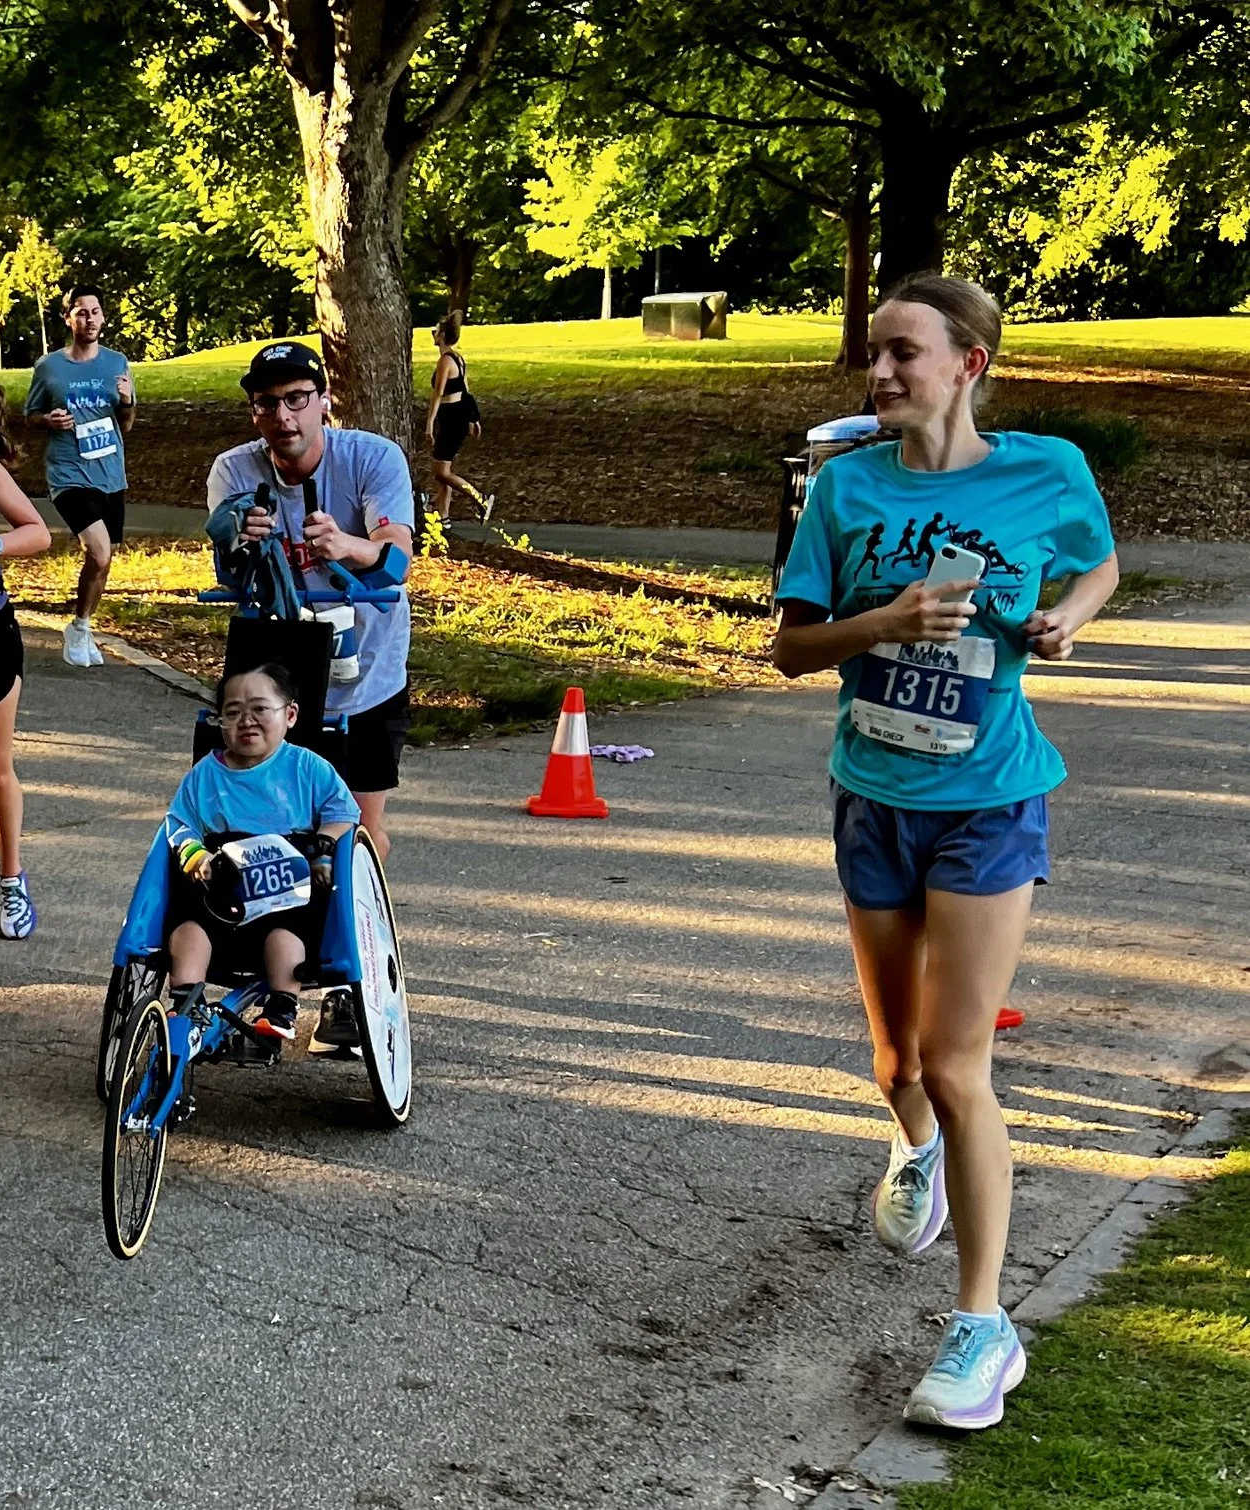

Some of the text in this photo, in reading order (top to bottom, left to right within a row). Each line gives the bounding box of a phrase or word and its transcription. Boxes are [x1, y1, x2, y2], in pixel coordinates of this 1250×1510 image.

[86, 433, 110, 450] 1172
[884, 666, 964, 716] 1315
[883, 730, 905, 742] CHECK
[242, 861, 295, 898] 1265
[978, 1345, 1005, 1388] HOKA
